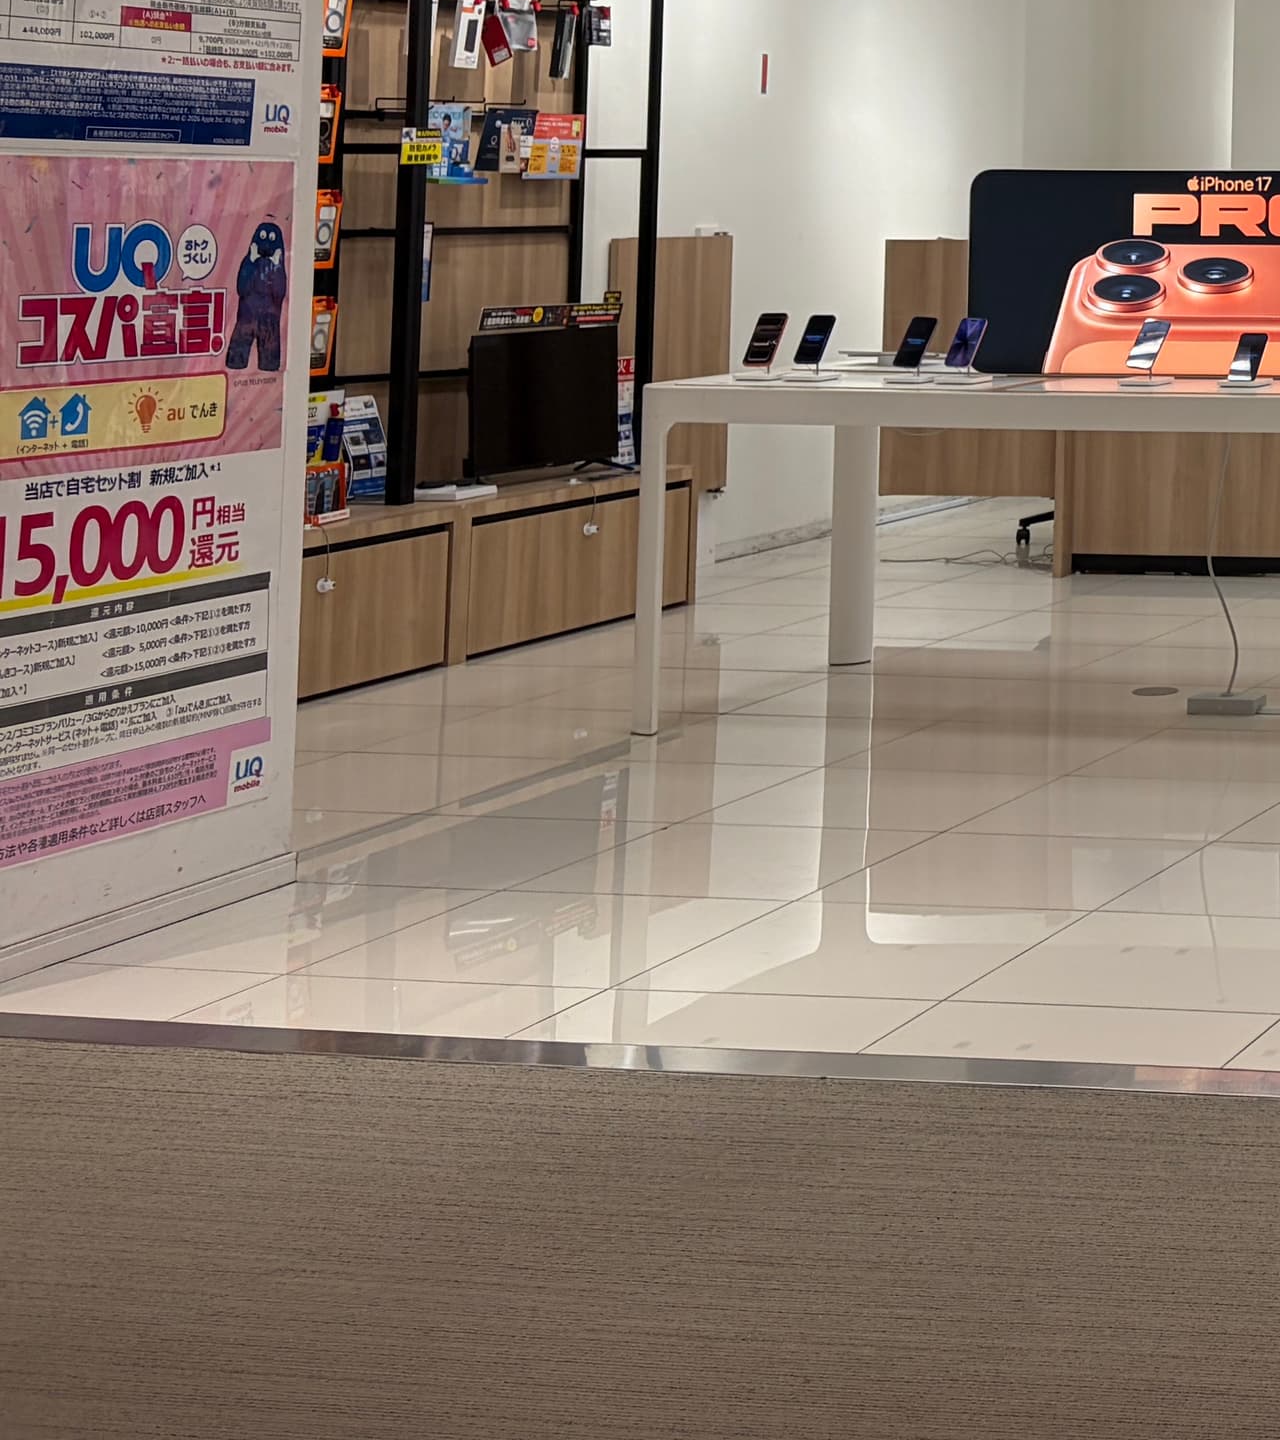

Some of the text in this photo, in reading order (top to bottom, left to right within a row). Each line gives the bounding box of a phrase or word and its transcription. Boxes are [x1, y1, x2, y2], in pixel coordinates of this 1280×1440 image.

[265, 103, 290, 126] UQ
[263, 126, 288, 134] mobile
[1200, 176, 1272, 192] iPhone 17
[74, 221, 171, 290] UQ
[188, 531, 241, 571] 還元
[235, 755, 264, 782] UQ
